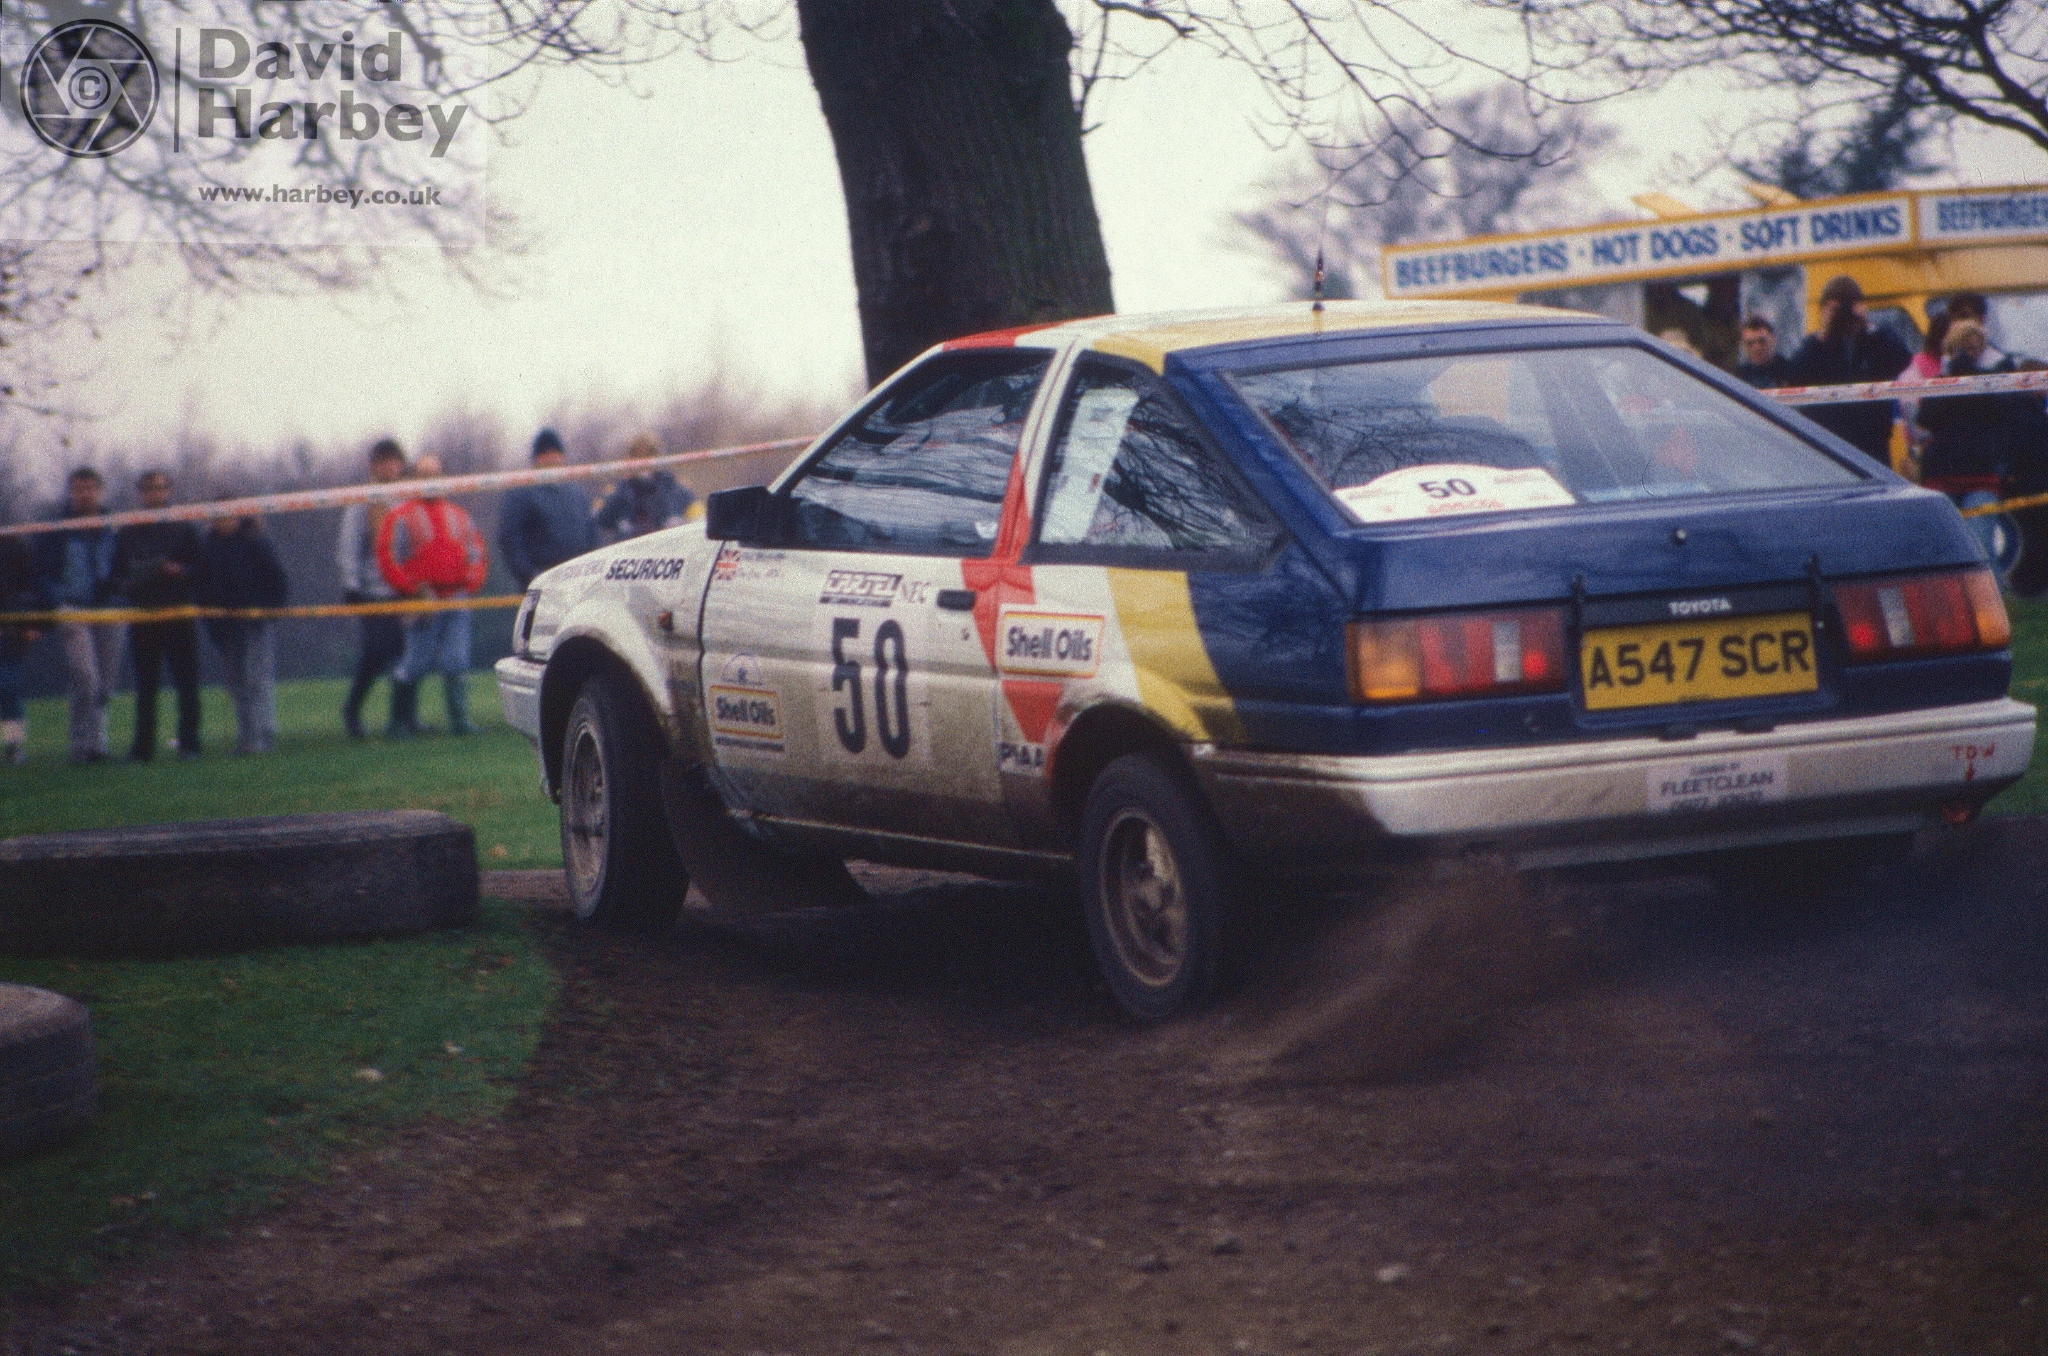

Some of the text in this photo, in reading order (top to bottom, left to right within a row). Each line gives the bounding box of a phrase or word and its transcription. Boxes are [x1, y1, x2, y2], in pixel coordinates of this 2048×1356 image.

[1396, 205, 1901, 288] BEEFBURGERS HOT DOGS SOFT DRINKS
[1419, 478, 1477, 500] 50
[605, 558, 684, 581] SECURICOR
[1668, 597, 1733, 616] TOYOTA
[1007, 626, 1092, 661] Shell Oils
[1589, 630, 1810, 690] A547 SCR
[832, 617, 910, 760] 50
[716, 696, 776, 726] Shell Oils
[1660, 770, 1774, 797] FLEETCLEAN
